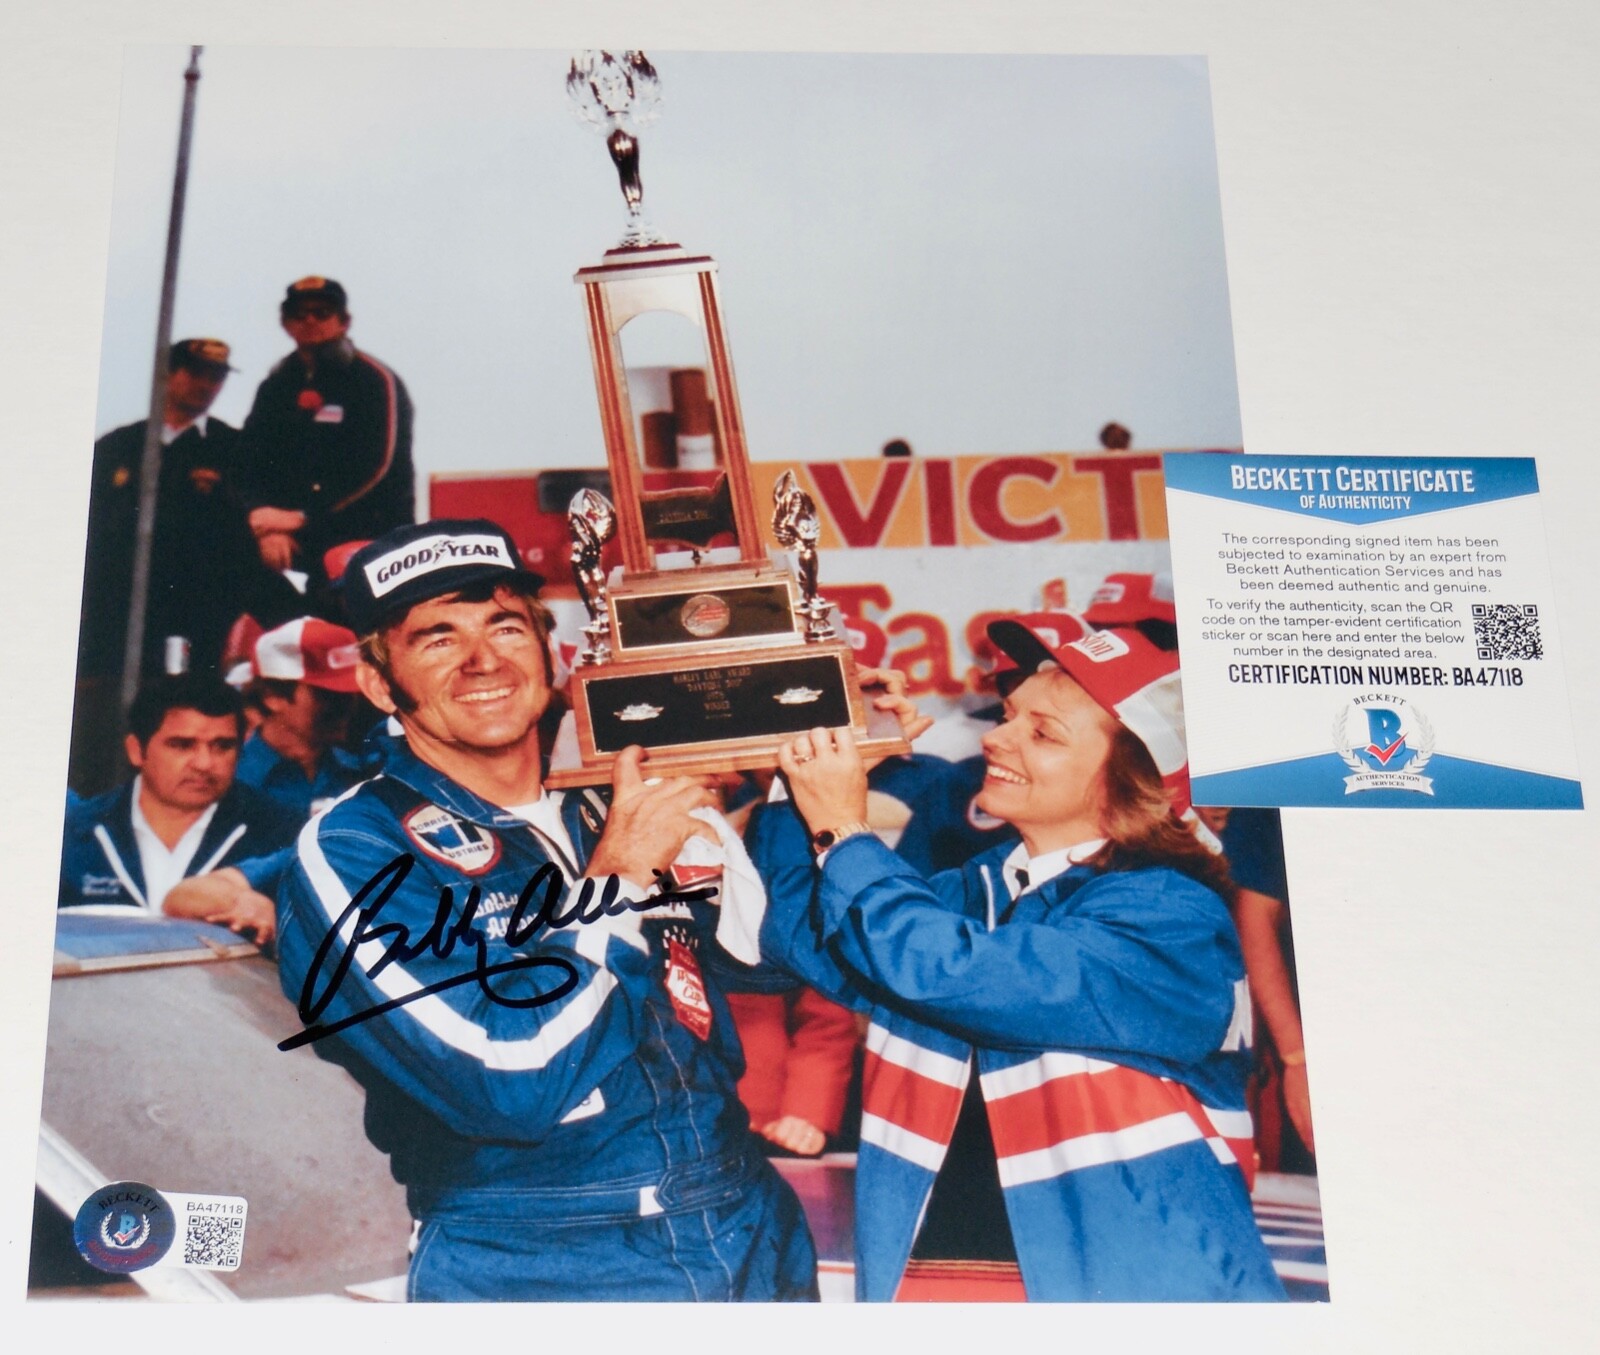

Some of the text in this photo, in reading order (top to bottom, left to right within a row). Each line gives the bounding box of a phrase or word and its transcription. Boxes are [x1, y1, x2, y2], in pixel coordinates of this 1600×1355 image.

[1231, 465, 1475, 493] BECKETT CERTIFICATE
[1300, 494, 1411, 510] OF AUTHENTICITY
[1222, 533, 1498, 549] The corresponding signed item has been
[1218, 548, 1507, 564] subjected to examination by an expert from
[1226, 563, 1502, 577] Beckett Authentication Services and has
[1239, 578, 1491, 595] been deemed authentic and genuine.
[1207, 599, 1453, 615] To verify the authenticity, scan the QR
[1202, 614, 1461, 629] code on the tamper-evident certification
[1202, 630, 1465, 643] sticker or scan here and enter the below
[1233, 645, 1437, 660] number in the designated area.
[1228, 664, 1524, 687] CERTIFICATION NUMBER: BA47118
[1353, 693, 1406, 706] BECKETT
[1355, 773, 1420, 782] AUTHENTICATION
[186, 1201, 243, 1214] BA47118
